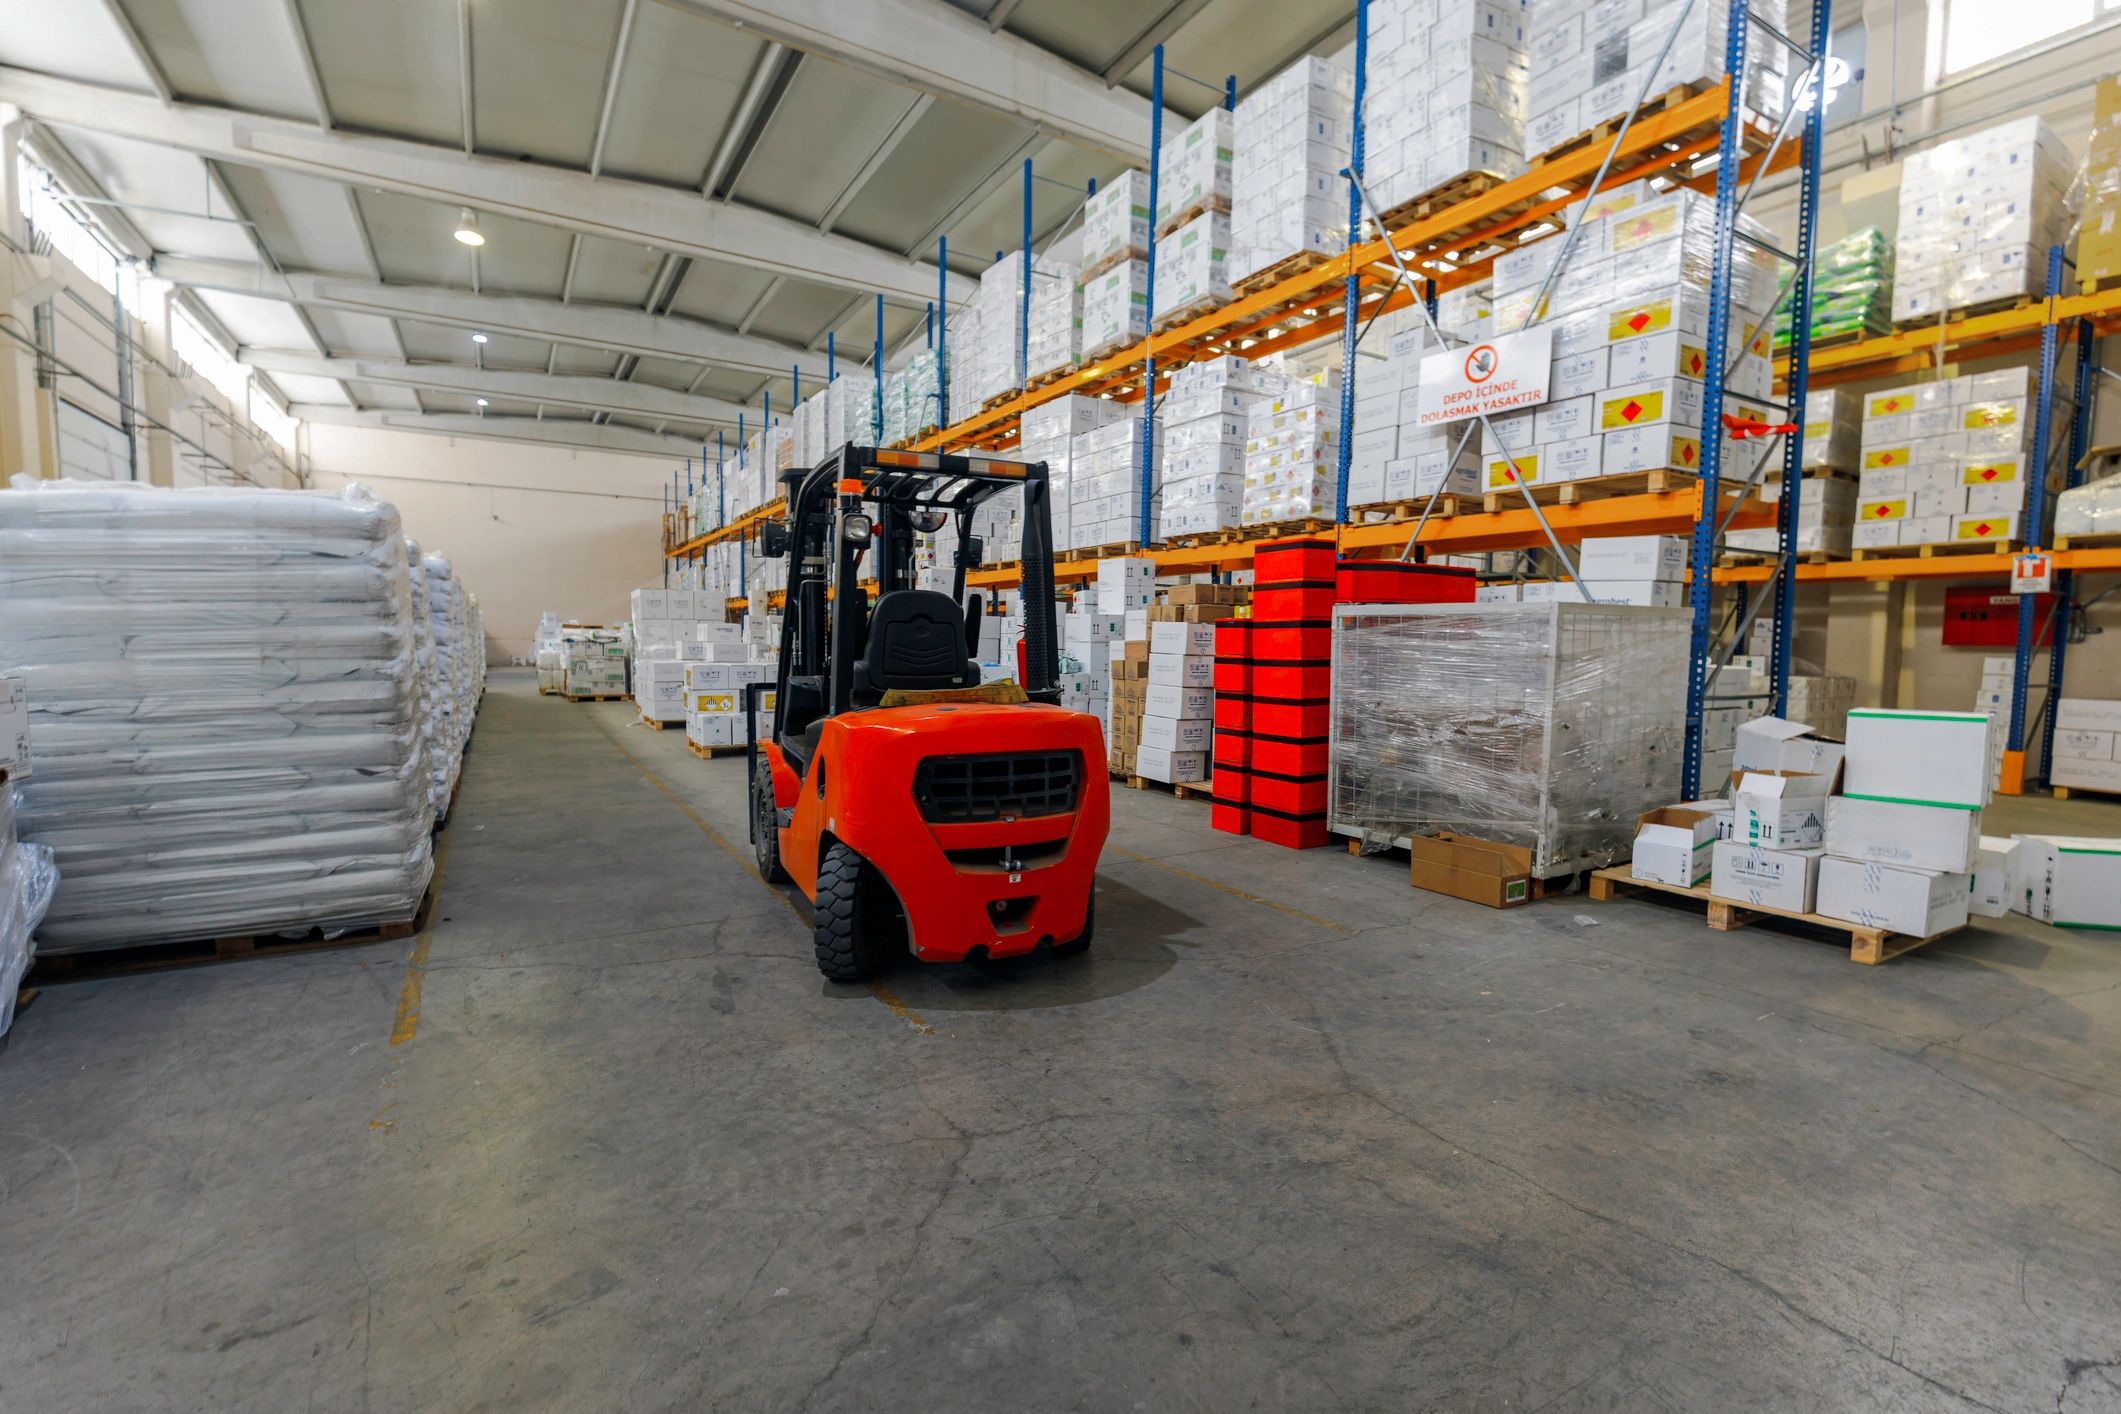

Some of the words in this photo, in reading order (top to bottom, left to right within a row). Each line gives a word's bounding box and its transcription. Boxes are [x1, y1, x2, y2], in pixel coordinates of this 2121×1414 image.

[1443, 390, 1472, 405] DEPO
[1475, 379, 1518, 399] İÇİNDE
[1482, 389, 1541, 411] YASAKTIR
